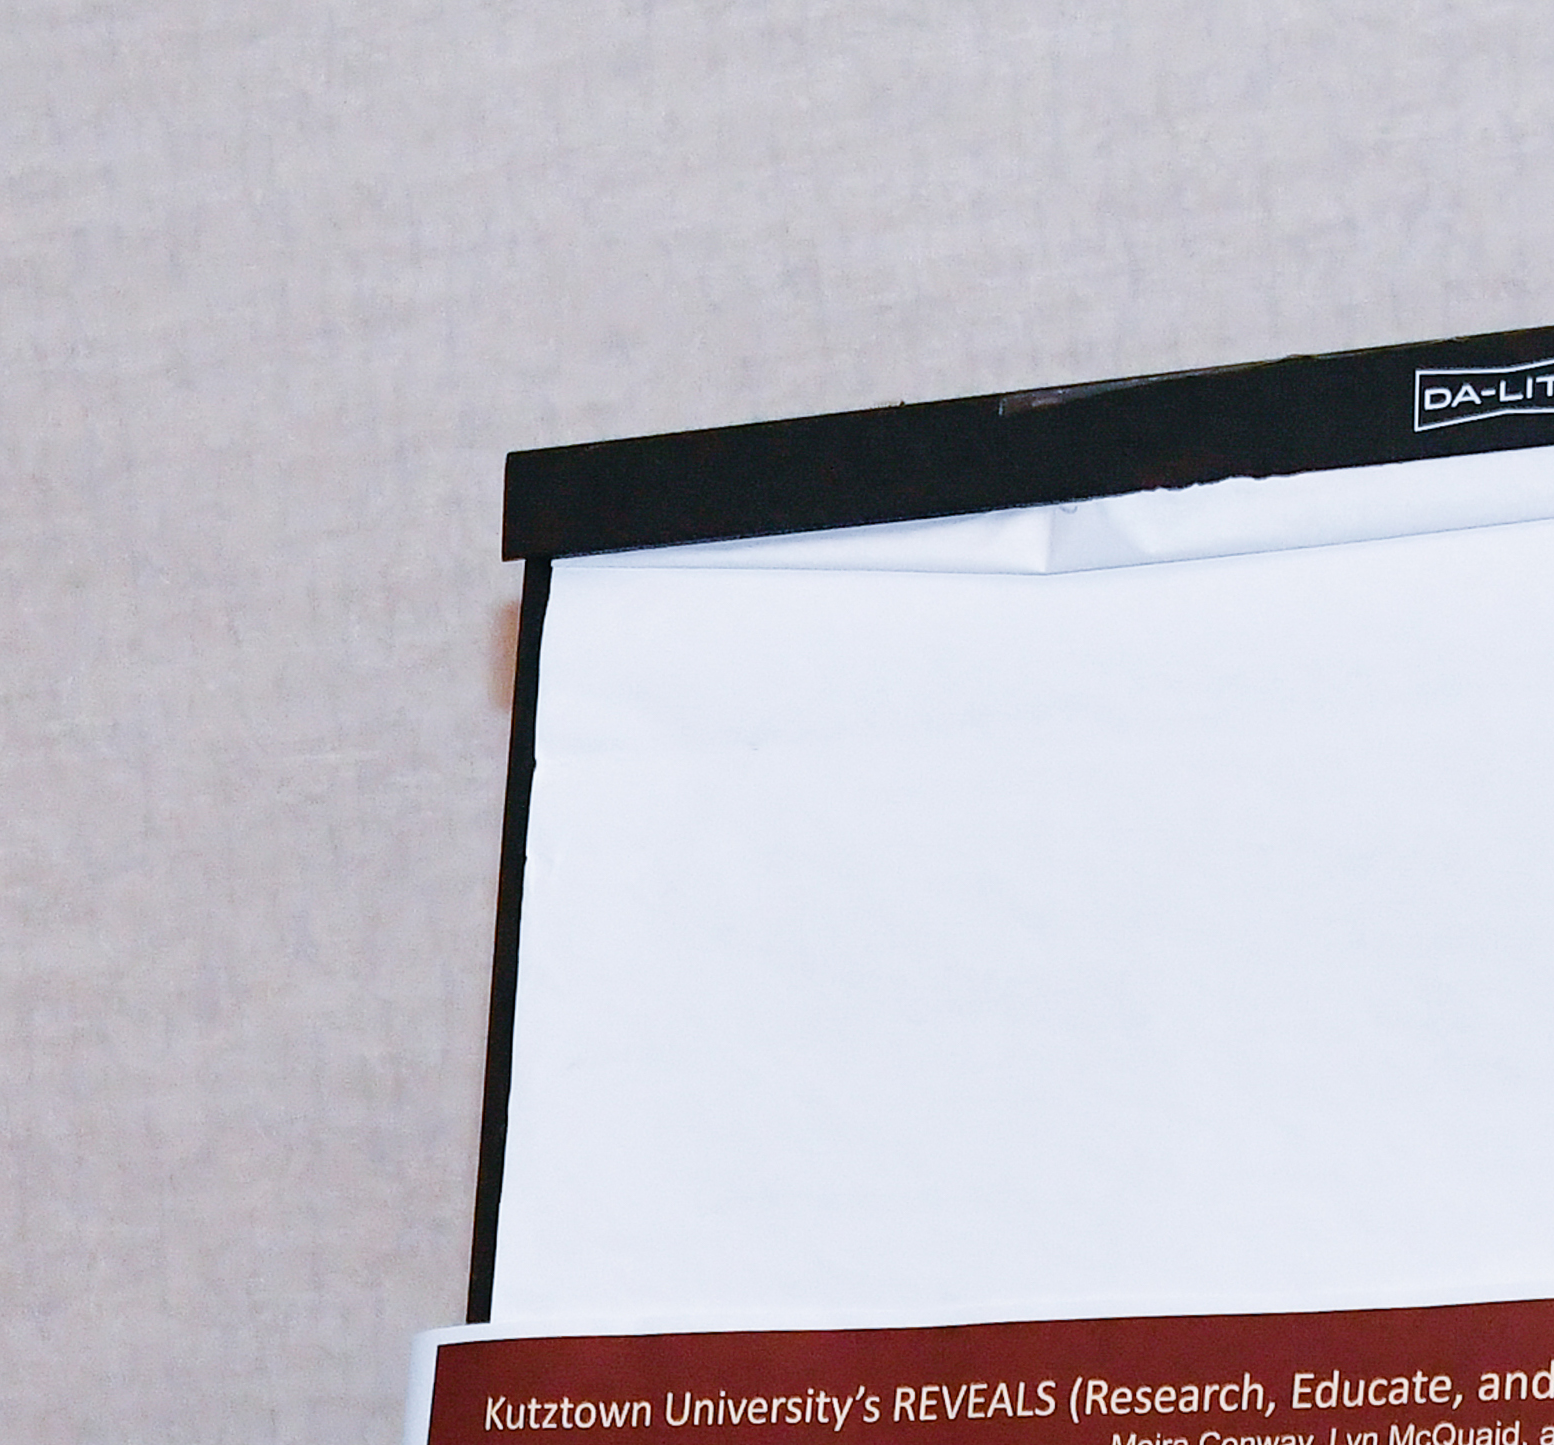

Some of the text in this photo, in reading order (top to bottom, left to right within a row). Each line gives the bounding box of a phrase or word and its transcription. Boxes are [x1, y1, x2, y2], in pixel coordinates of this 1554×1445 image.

[485, 1396, 651, 1430] Kutztown
[666, 1385, 880, 1431] University's
[894, 1380, 1056, 1422] REVEALS
[1070, 1372, 1275, 1423] (Research,
[1292, 1370, 1462, 1409] Educate,
